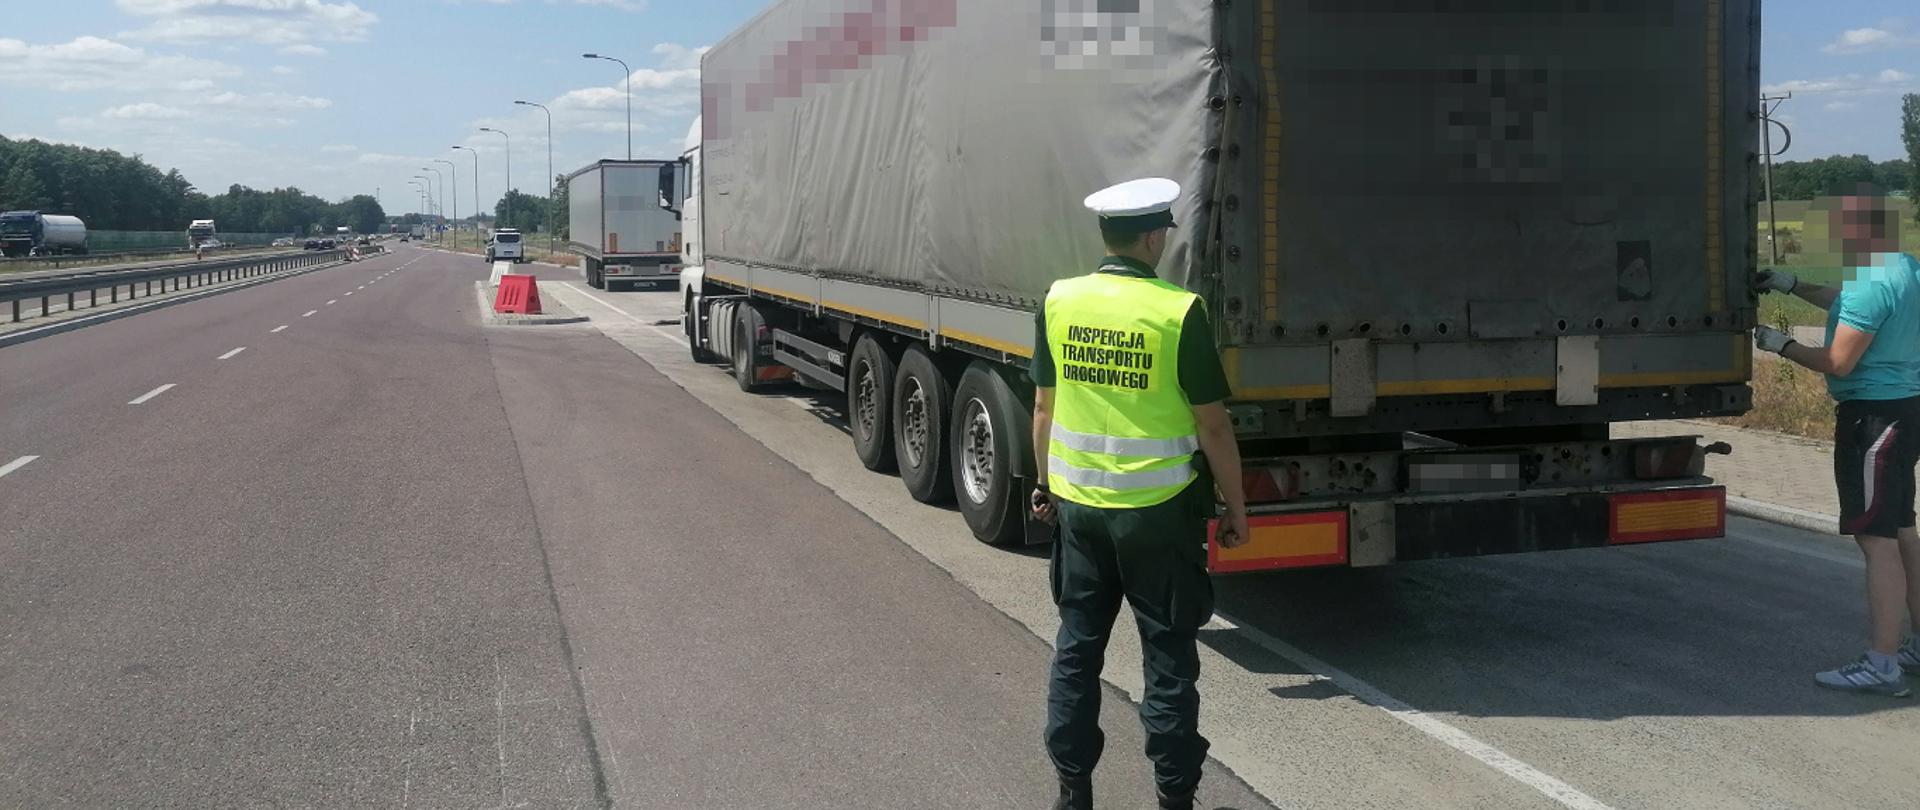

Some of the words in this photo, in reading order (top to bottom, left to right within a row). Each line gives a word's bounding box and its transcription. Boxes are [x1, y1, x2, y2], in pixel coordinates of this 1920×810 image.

[1068, 325, 1145, 349] INSPEKCJA
[1062, 344, 1152, 369] TRANSPORTU
[1064, 364, 1149, 390] DROGOWEGO
